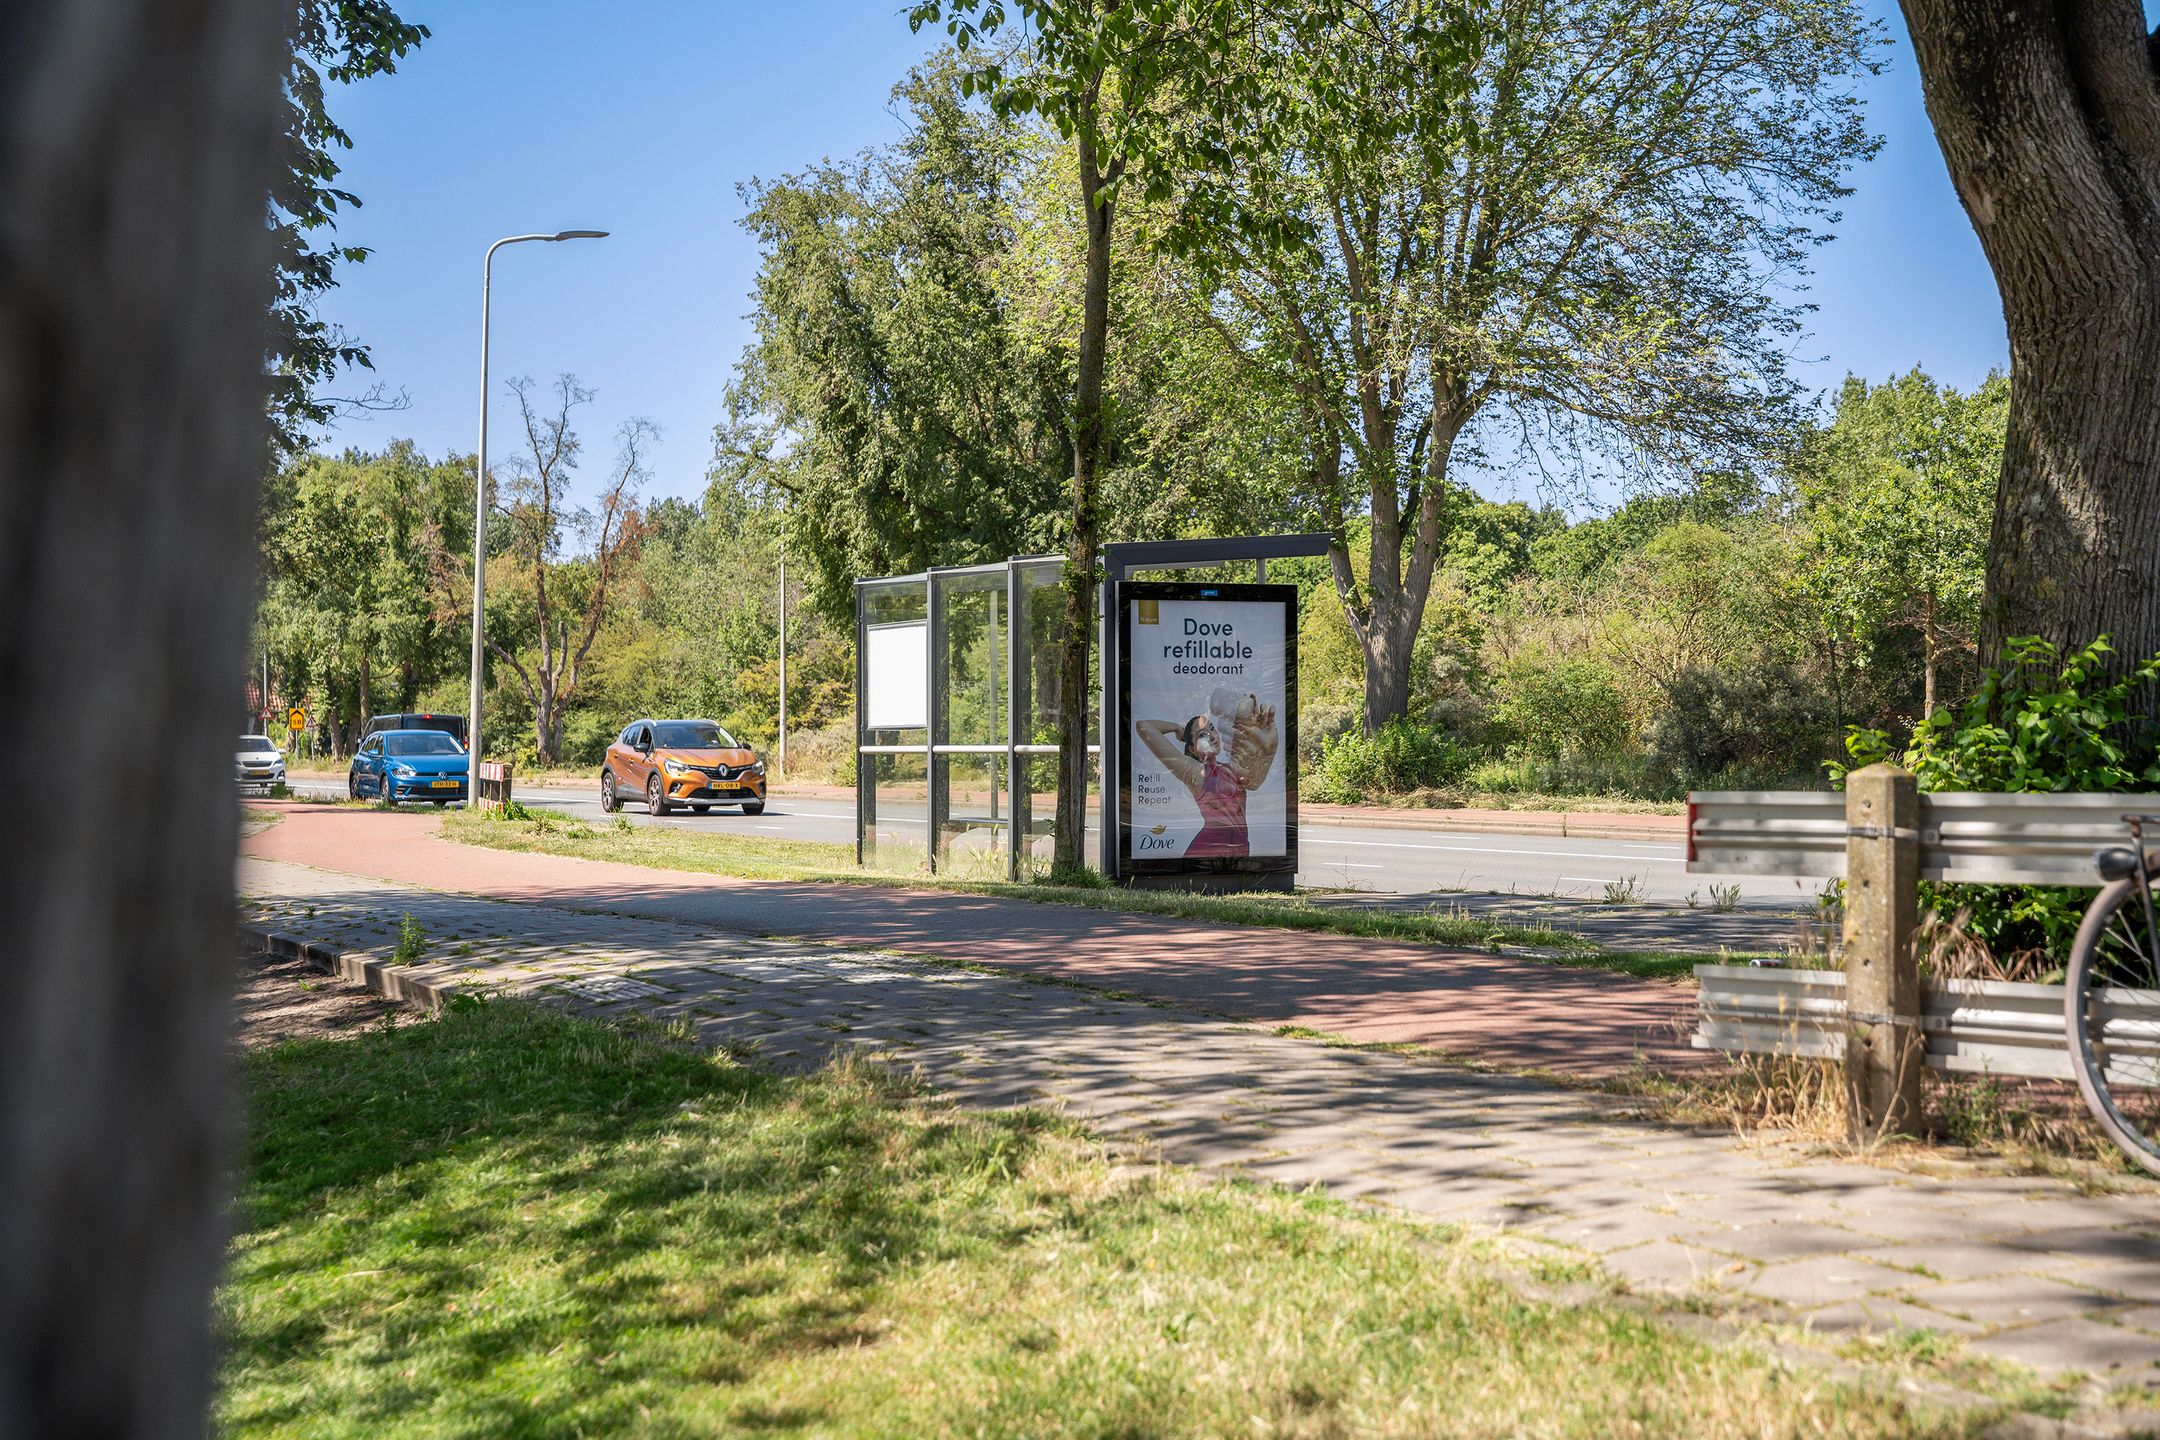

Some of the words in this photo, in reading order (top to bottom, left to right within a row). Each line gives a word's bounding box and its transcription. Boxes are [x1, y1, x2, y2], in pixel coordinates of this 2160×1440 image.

[1184, 618, 1233, 636] Dove
[1163, 640, 1253, 659] refillable
[1173, 662, 1244, 675] deodorant
[1138, 774, 1161, 783] Refill
[1138, 785, 1166, 794] Reuse
[1138, 795, 1171, 806] Repeat
[1140, 834, 1175, 850] Dove
